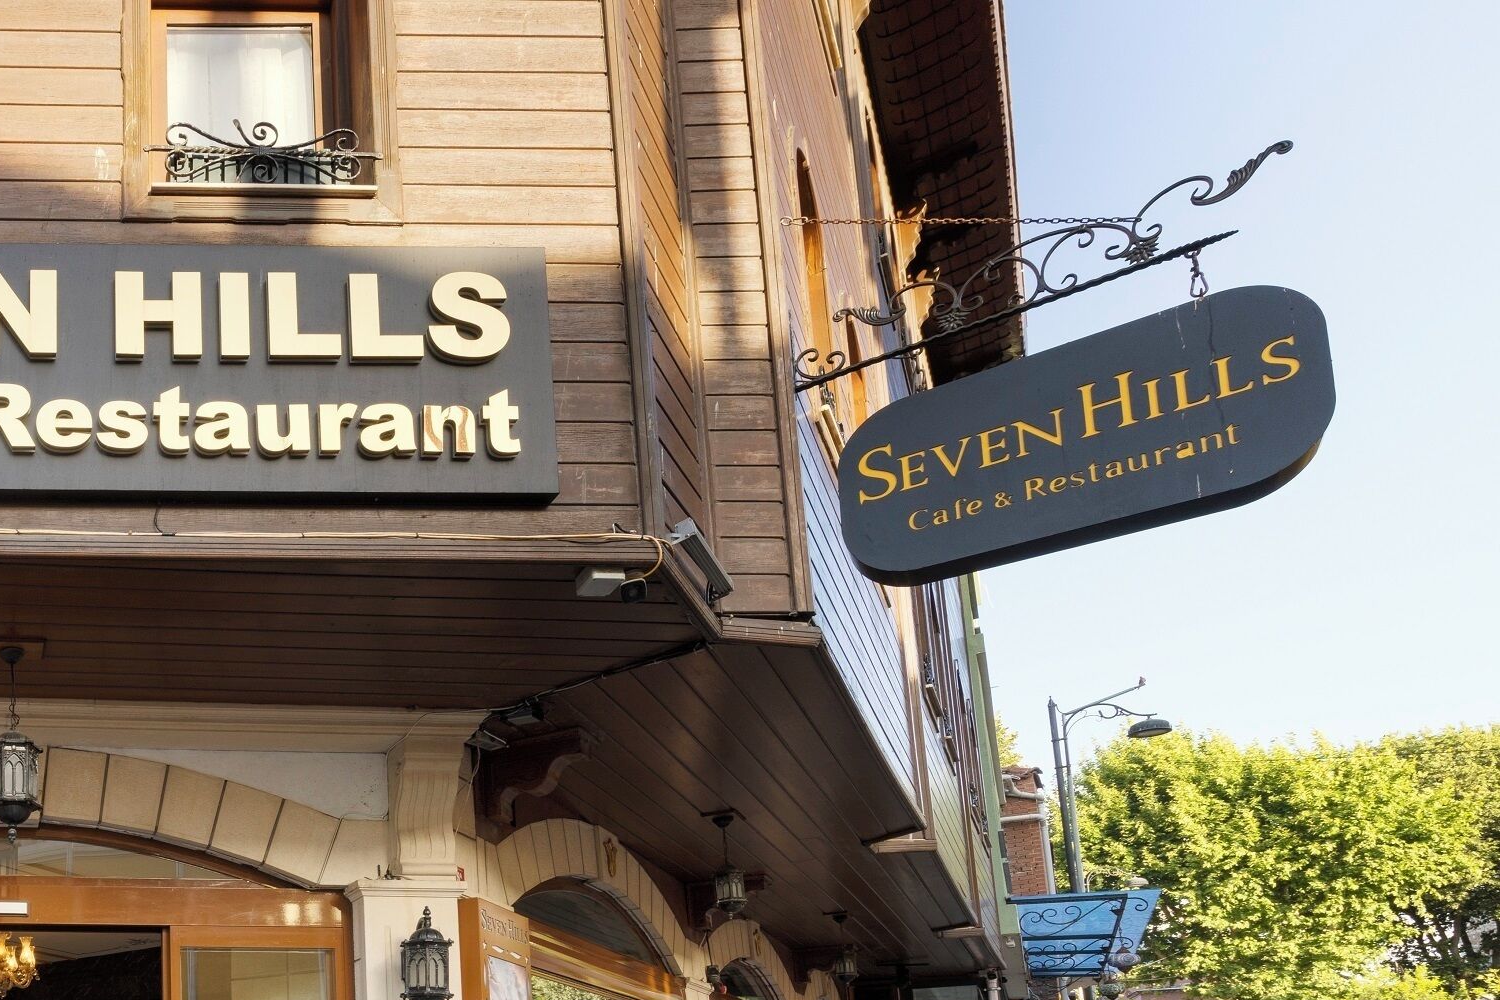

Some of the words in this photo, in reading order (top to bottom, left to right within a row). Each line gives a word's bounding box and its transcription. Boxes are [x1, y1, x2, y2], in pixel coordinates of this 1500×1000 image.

[114, 271, 511, 365] HILLS
[908, 497, 984, 533] Cafe
[994, 491, 1013, 508] &
[1024, 422, 1243, 502] Restaurant
